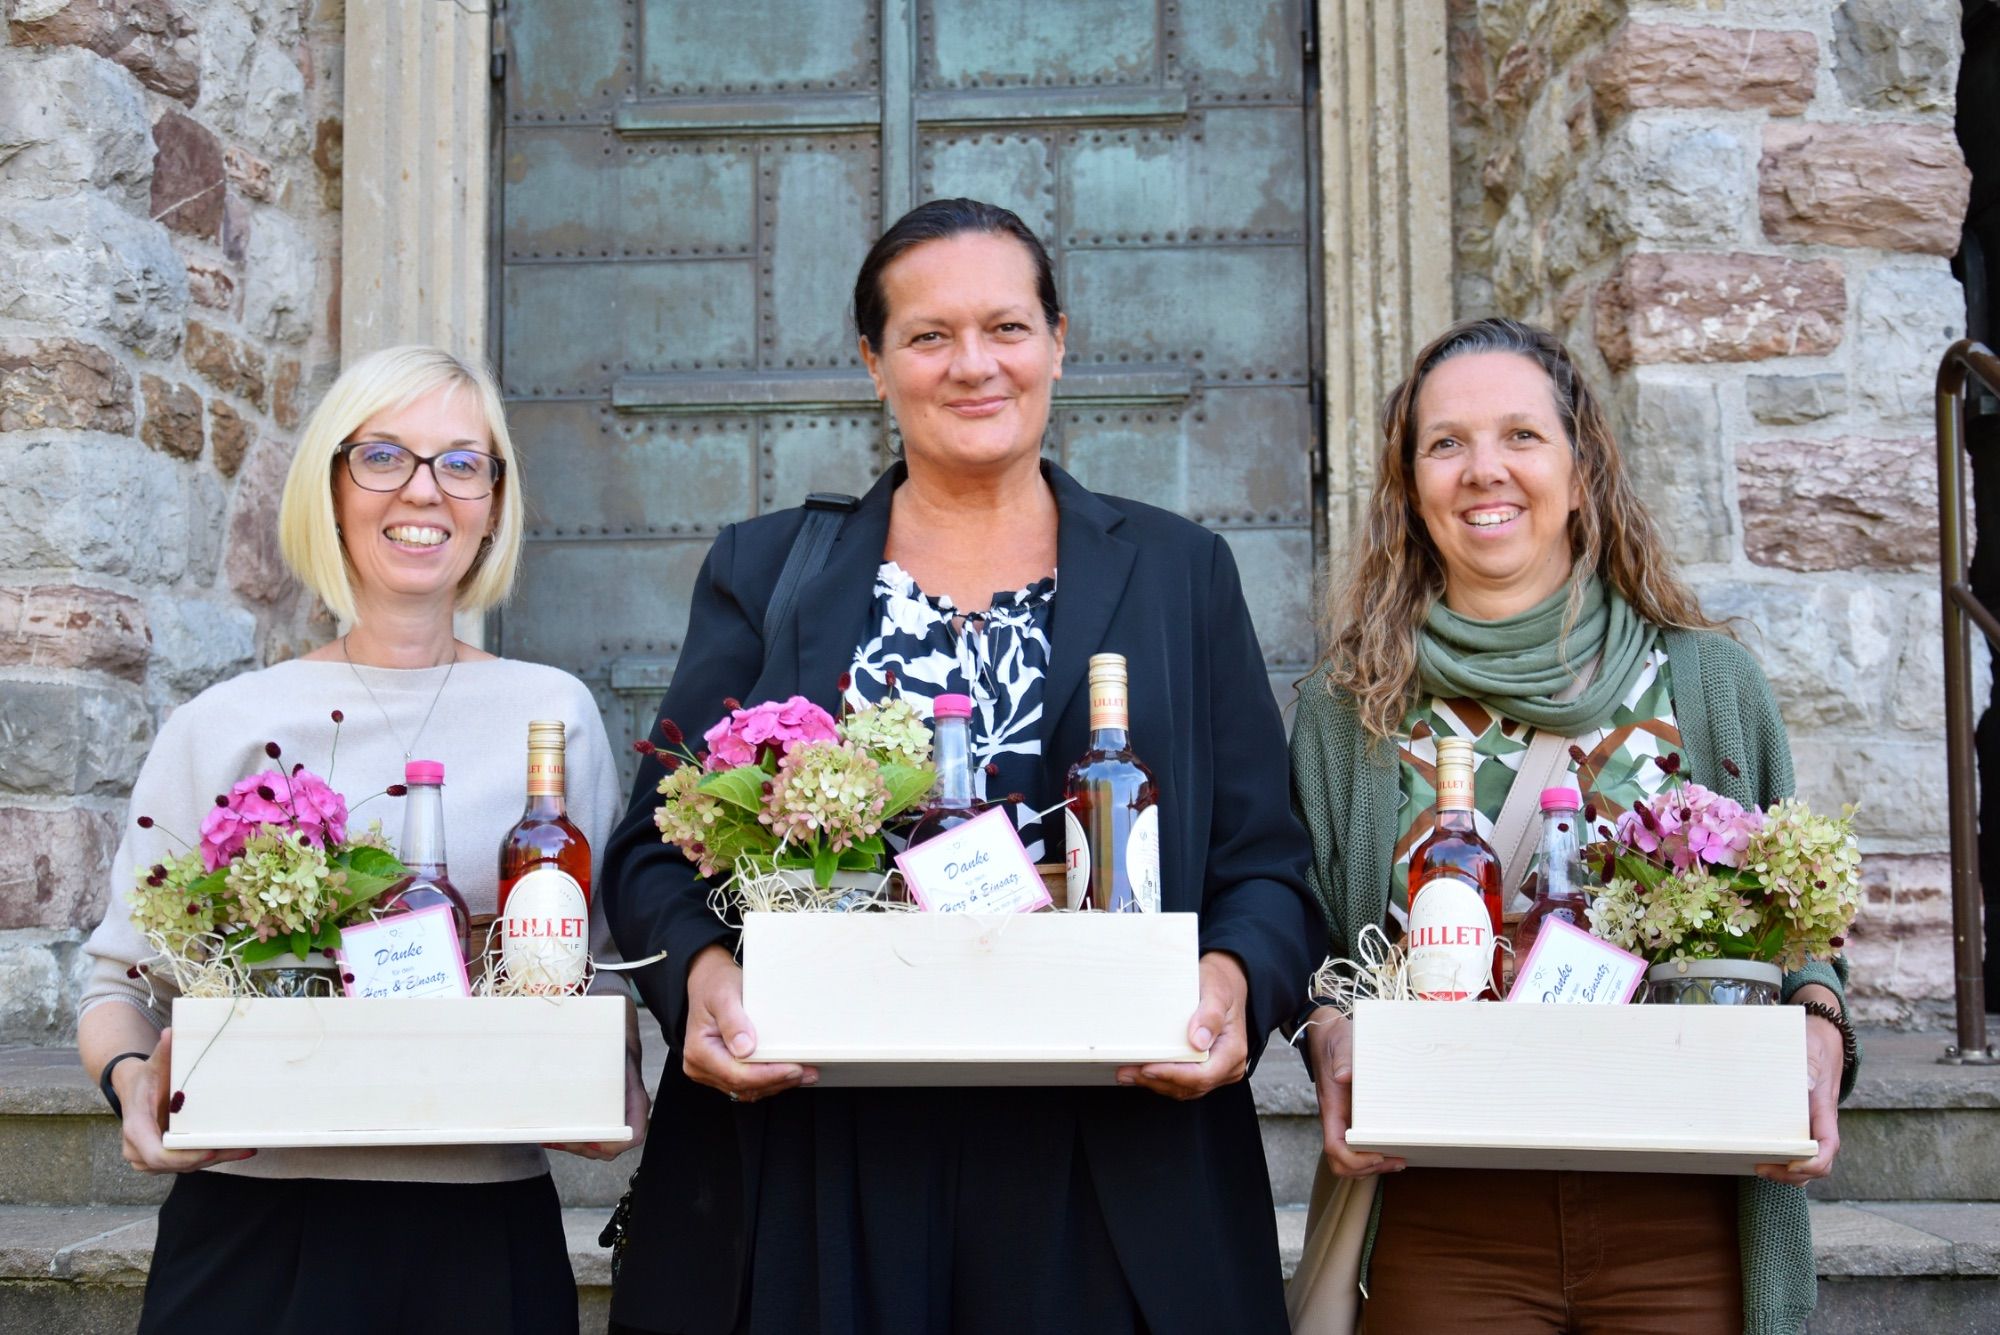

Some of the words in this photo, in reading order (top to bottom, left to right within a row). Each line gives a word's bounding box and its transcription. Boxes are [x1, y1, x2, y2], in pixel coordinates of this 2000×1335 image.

[943, 850, 990, 880] Danke
[508, 918, 585, 938] LILLET
[1411, 926, 1485, 948] LILLET
[374, 941, 423, 966] Danke
[393, 980, 401, 992] &
[1542, 963, 1573, 1004] Danke
